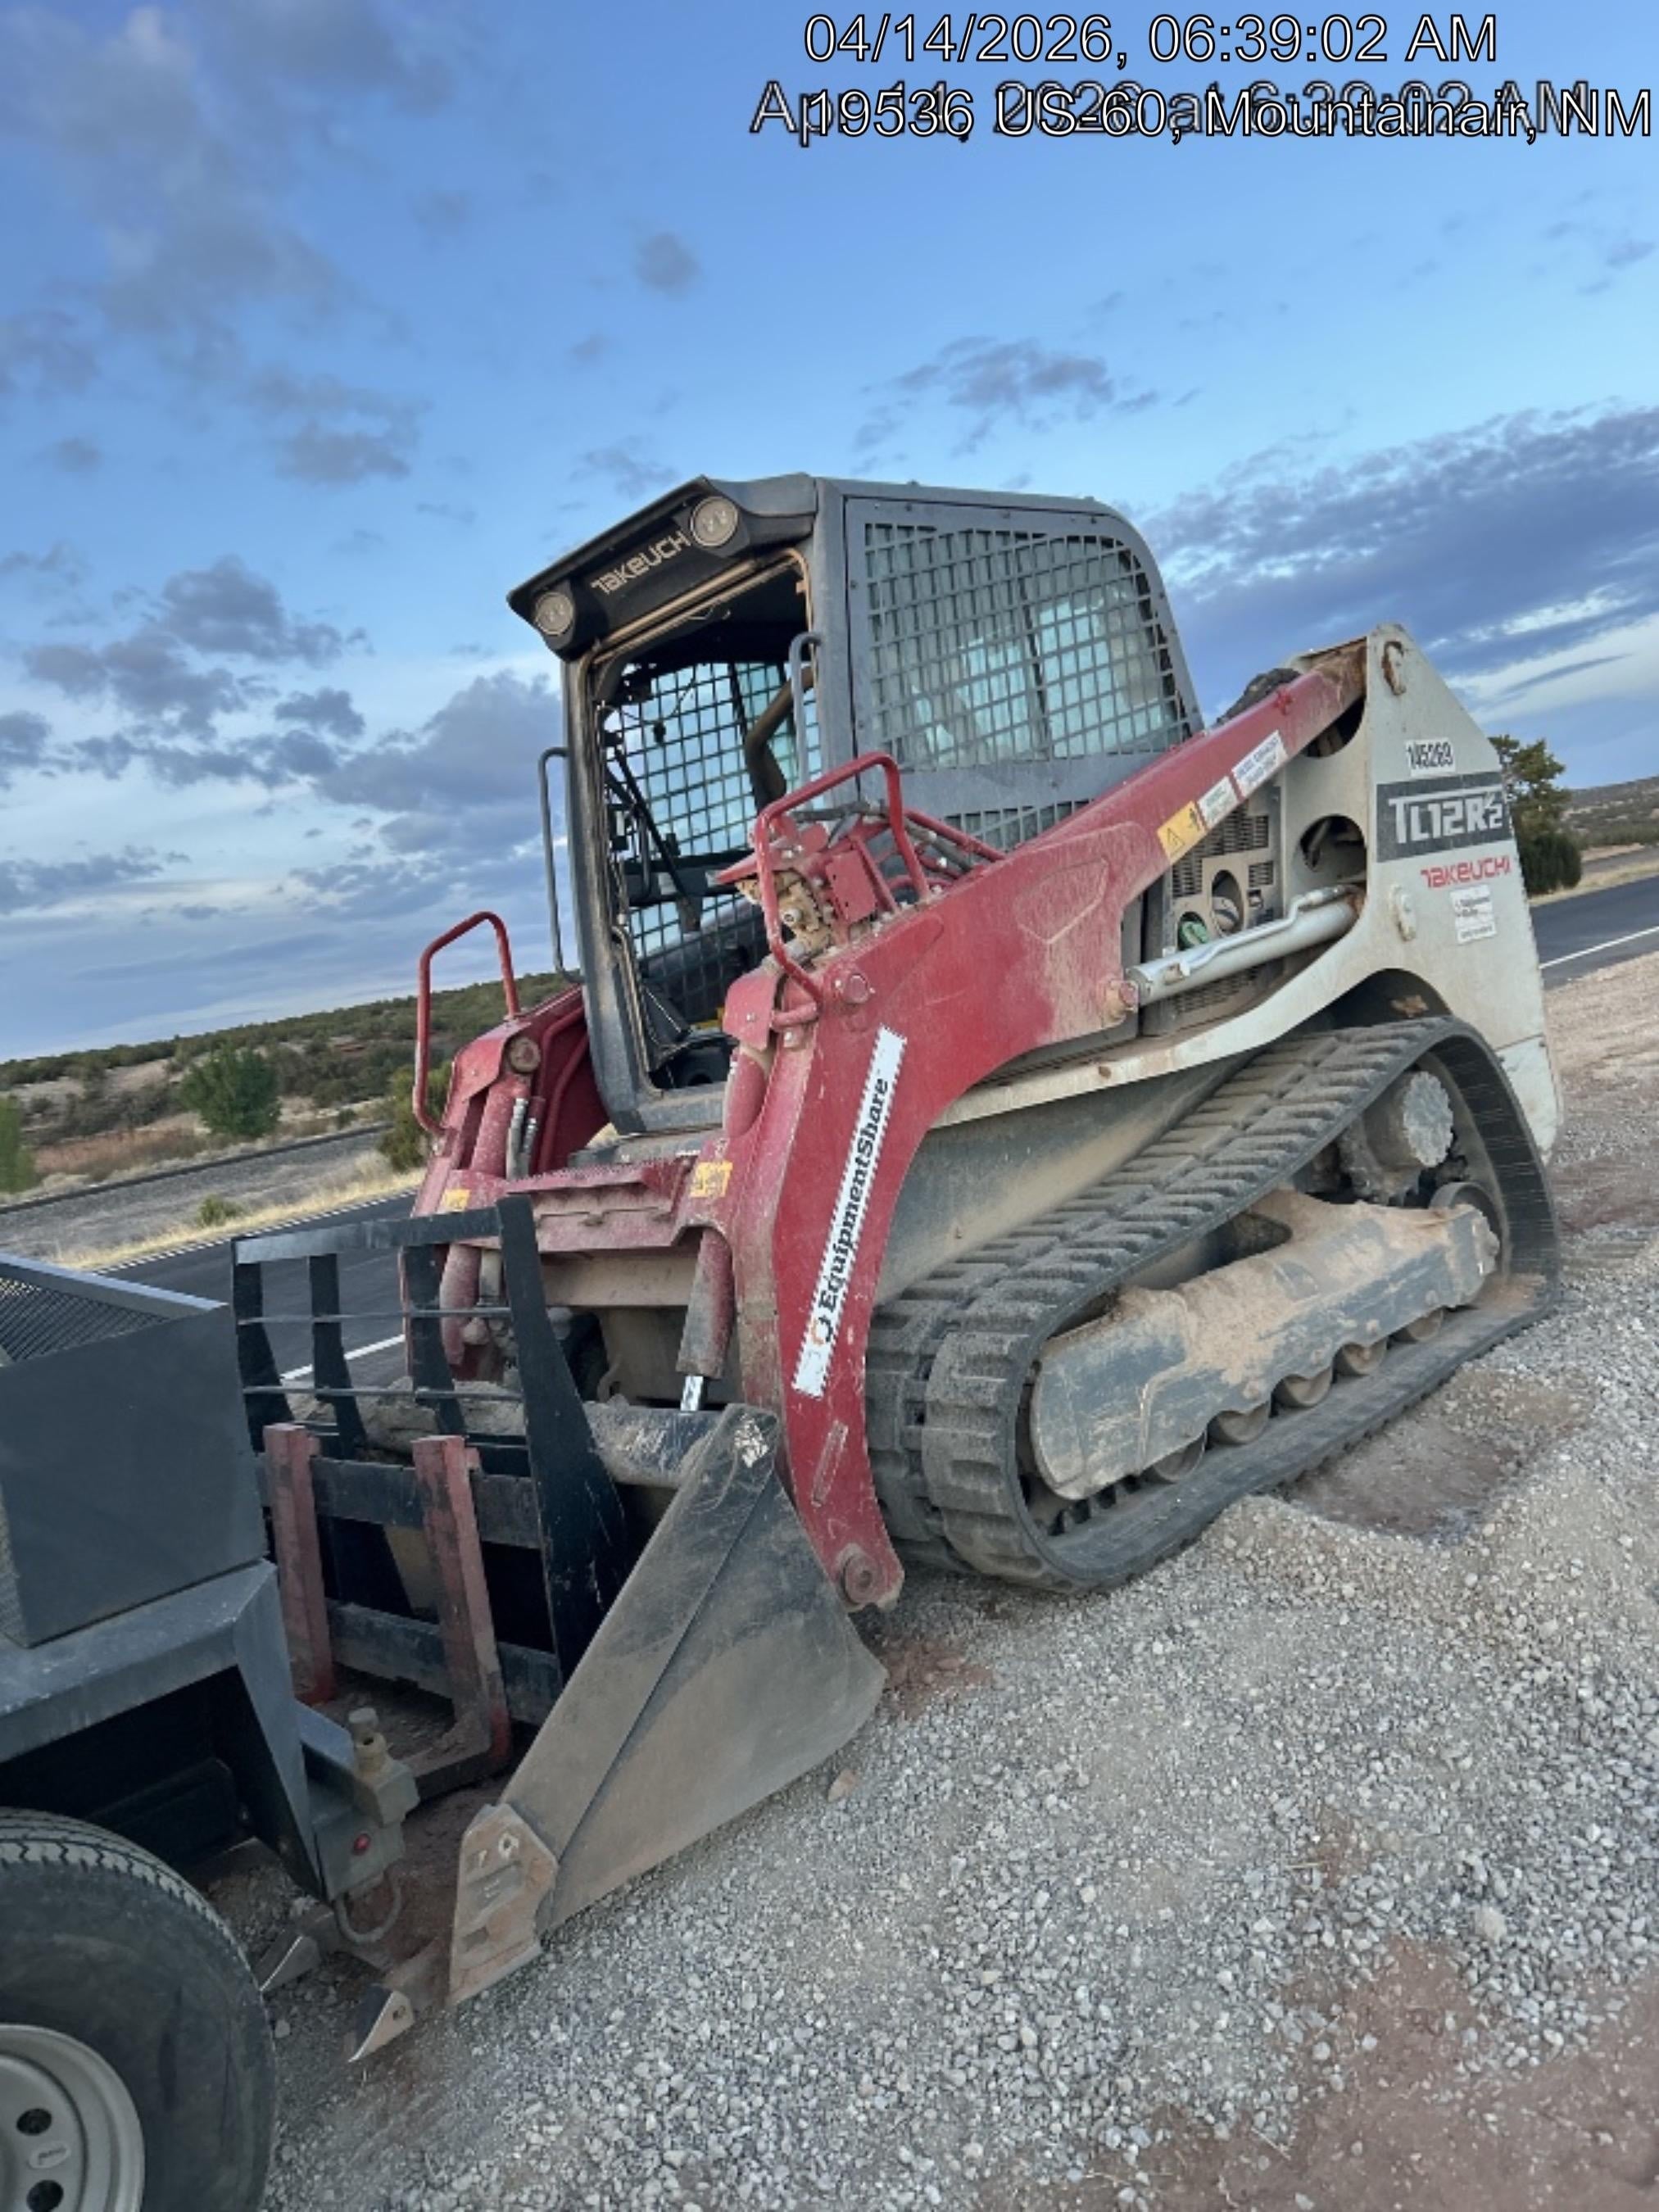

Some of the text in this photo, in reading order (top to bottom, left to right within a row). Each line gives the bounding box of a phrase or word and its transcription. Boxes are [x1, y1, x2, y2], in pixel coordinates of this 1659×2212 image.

[590, 530, 691, 596] TAKEUCH
[1419, 854, 1511, 889] TAKEUCHI
[818, 1077, 889, 1313] EquipmentShare
